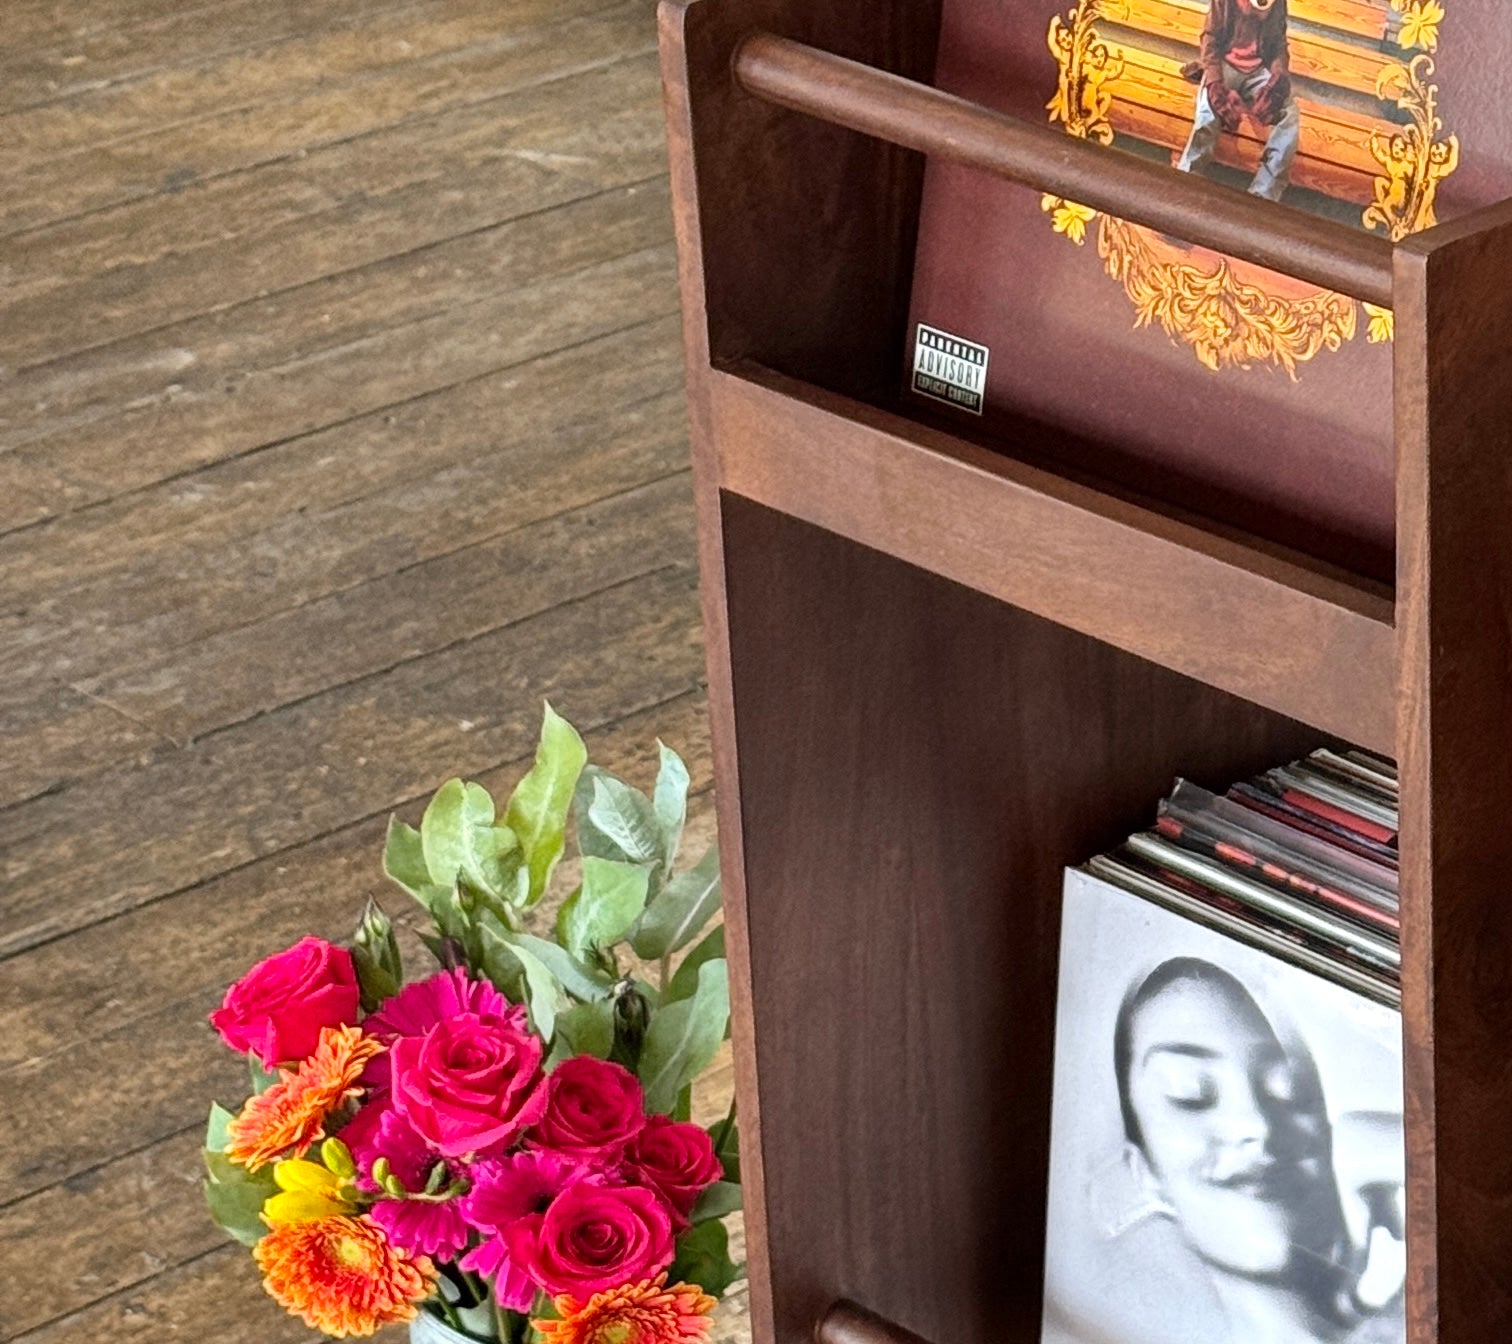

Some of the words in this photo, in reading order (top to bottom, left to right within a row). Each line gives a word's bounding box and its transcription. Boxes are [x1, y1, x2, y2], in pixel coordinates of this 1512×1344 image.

[921, 330, 984, 366] PARENTAL
[918, 348, 982, 390] ADVISORY
[917, 375, 947, 395] EXPLICIT
[947, 384, 979, 409] CONTENT
